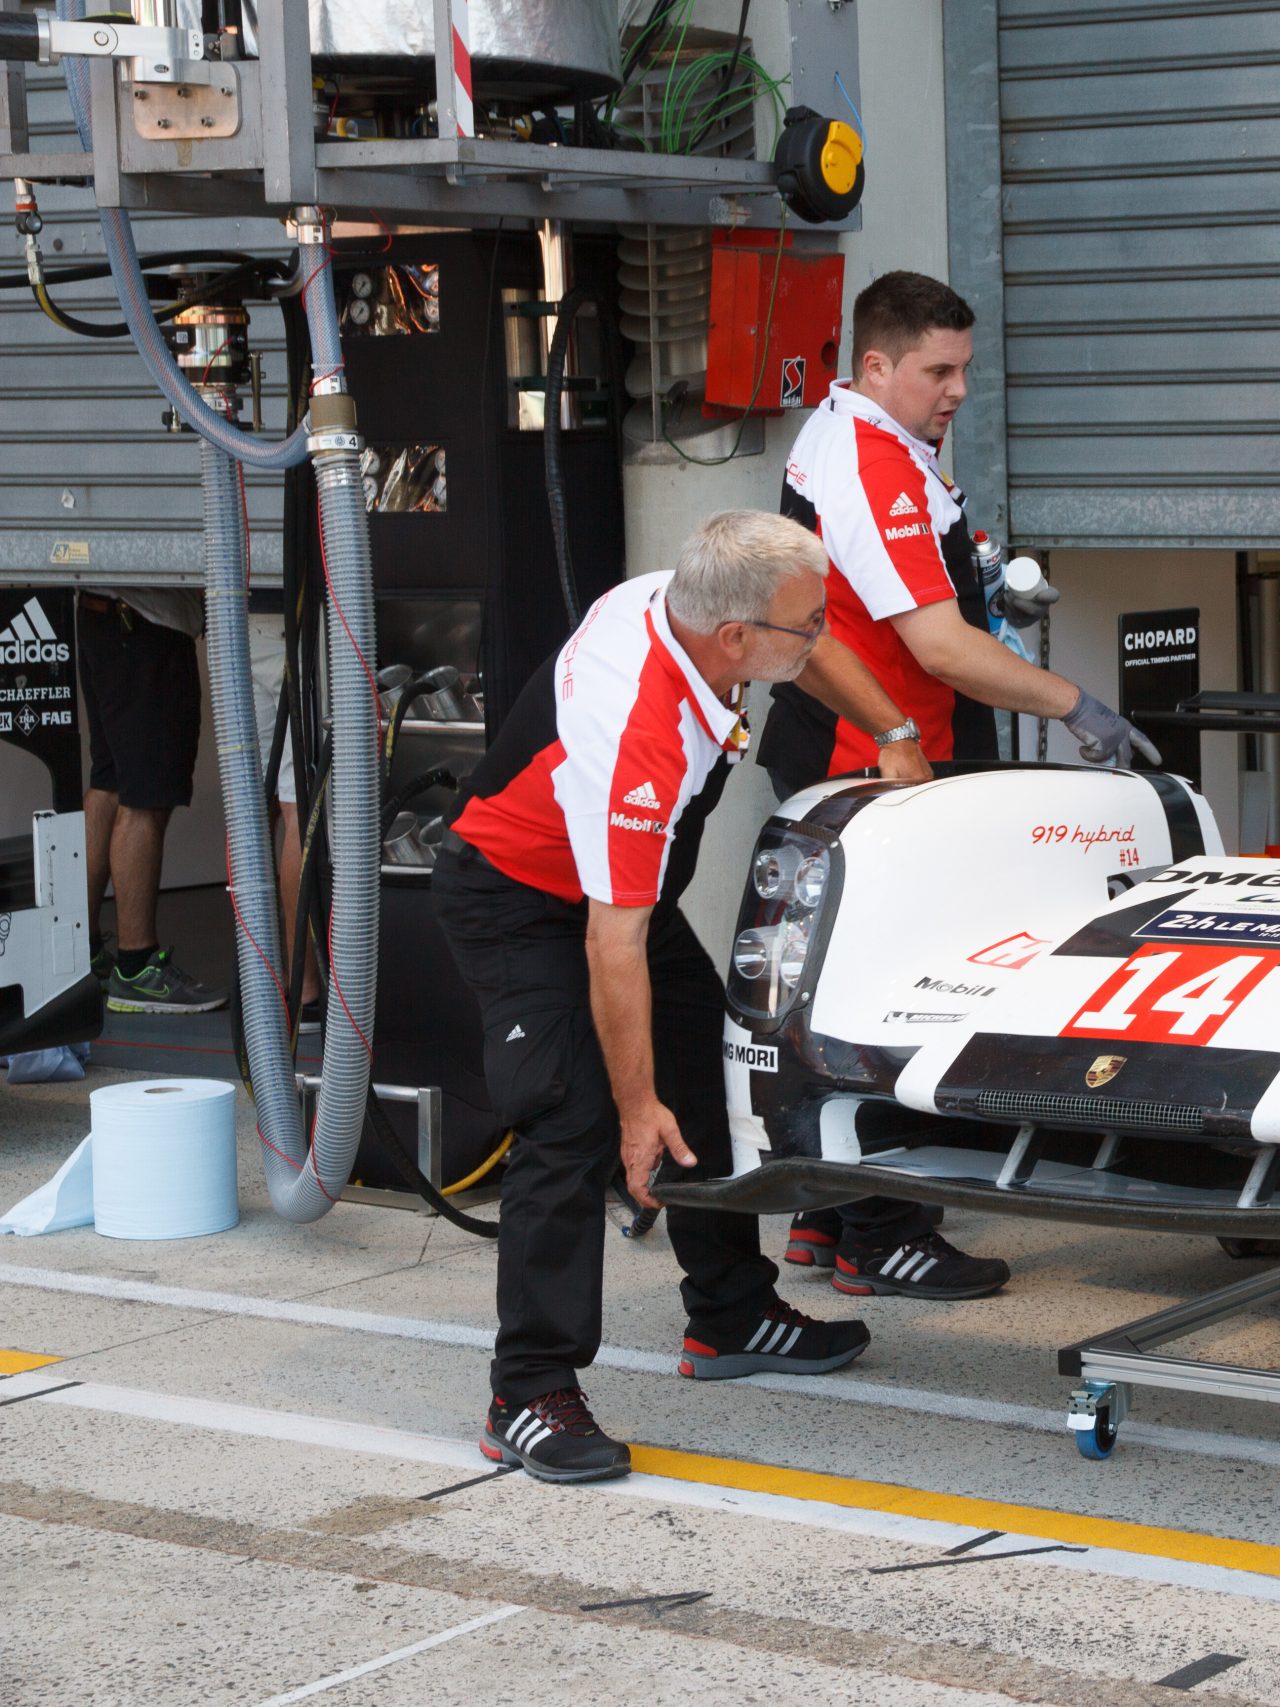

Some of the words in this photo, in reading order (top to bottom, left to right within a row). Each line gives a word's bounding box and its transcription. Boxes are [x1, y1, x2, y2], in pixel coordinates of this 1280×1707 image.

[889, 506, 918, 517] adidas
[885, 525, 921, 541] Mobil
[1124, 627, 1196, 651] CHOPARD
[1124, 658, 1150, 667] OFFICIAL
[1150, 656, 1170, 664] TIMING
[1170, 653, 1196, 662] PARTNER
[0, 686, 71, 702] CHAEFFLER
[41, 711, 72, 726] FAG
[623, 795, 661, 810] adidas
[610, 812, 652, 832] Mobil
[1032, 825, 1068, 844] 919
[1071, 824, 1136, 855] hybrid
[1119, 848, 1140, 867] #14
[1214, 922, 1255, 932] LE
[913, 976, 985, 996] Mobil
[1072, 951, 1265, 1036] 14
[735, 1045, 774, 1068] MORI
